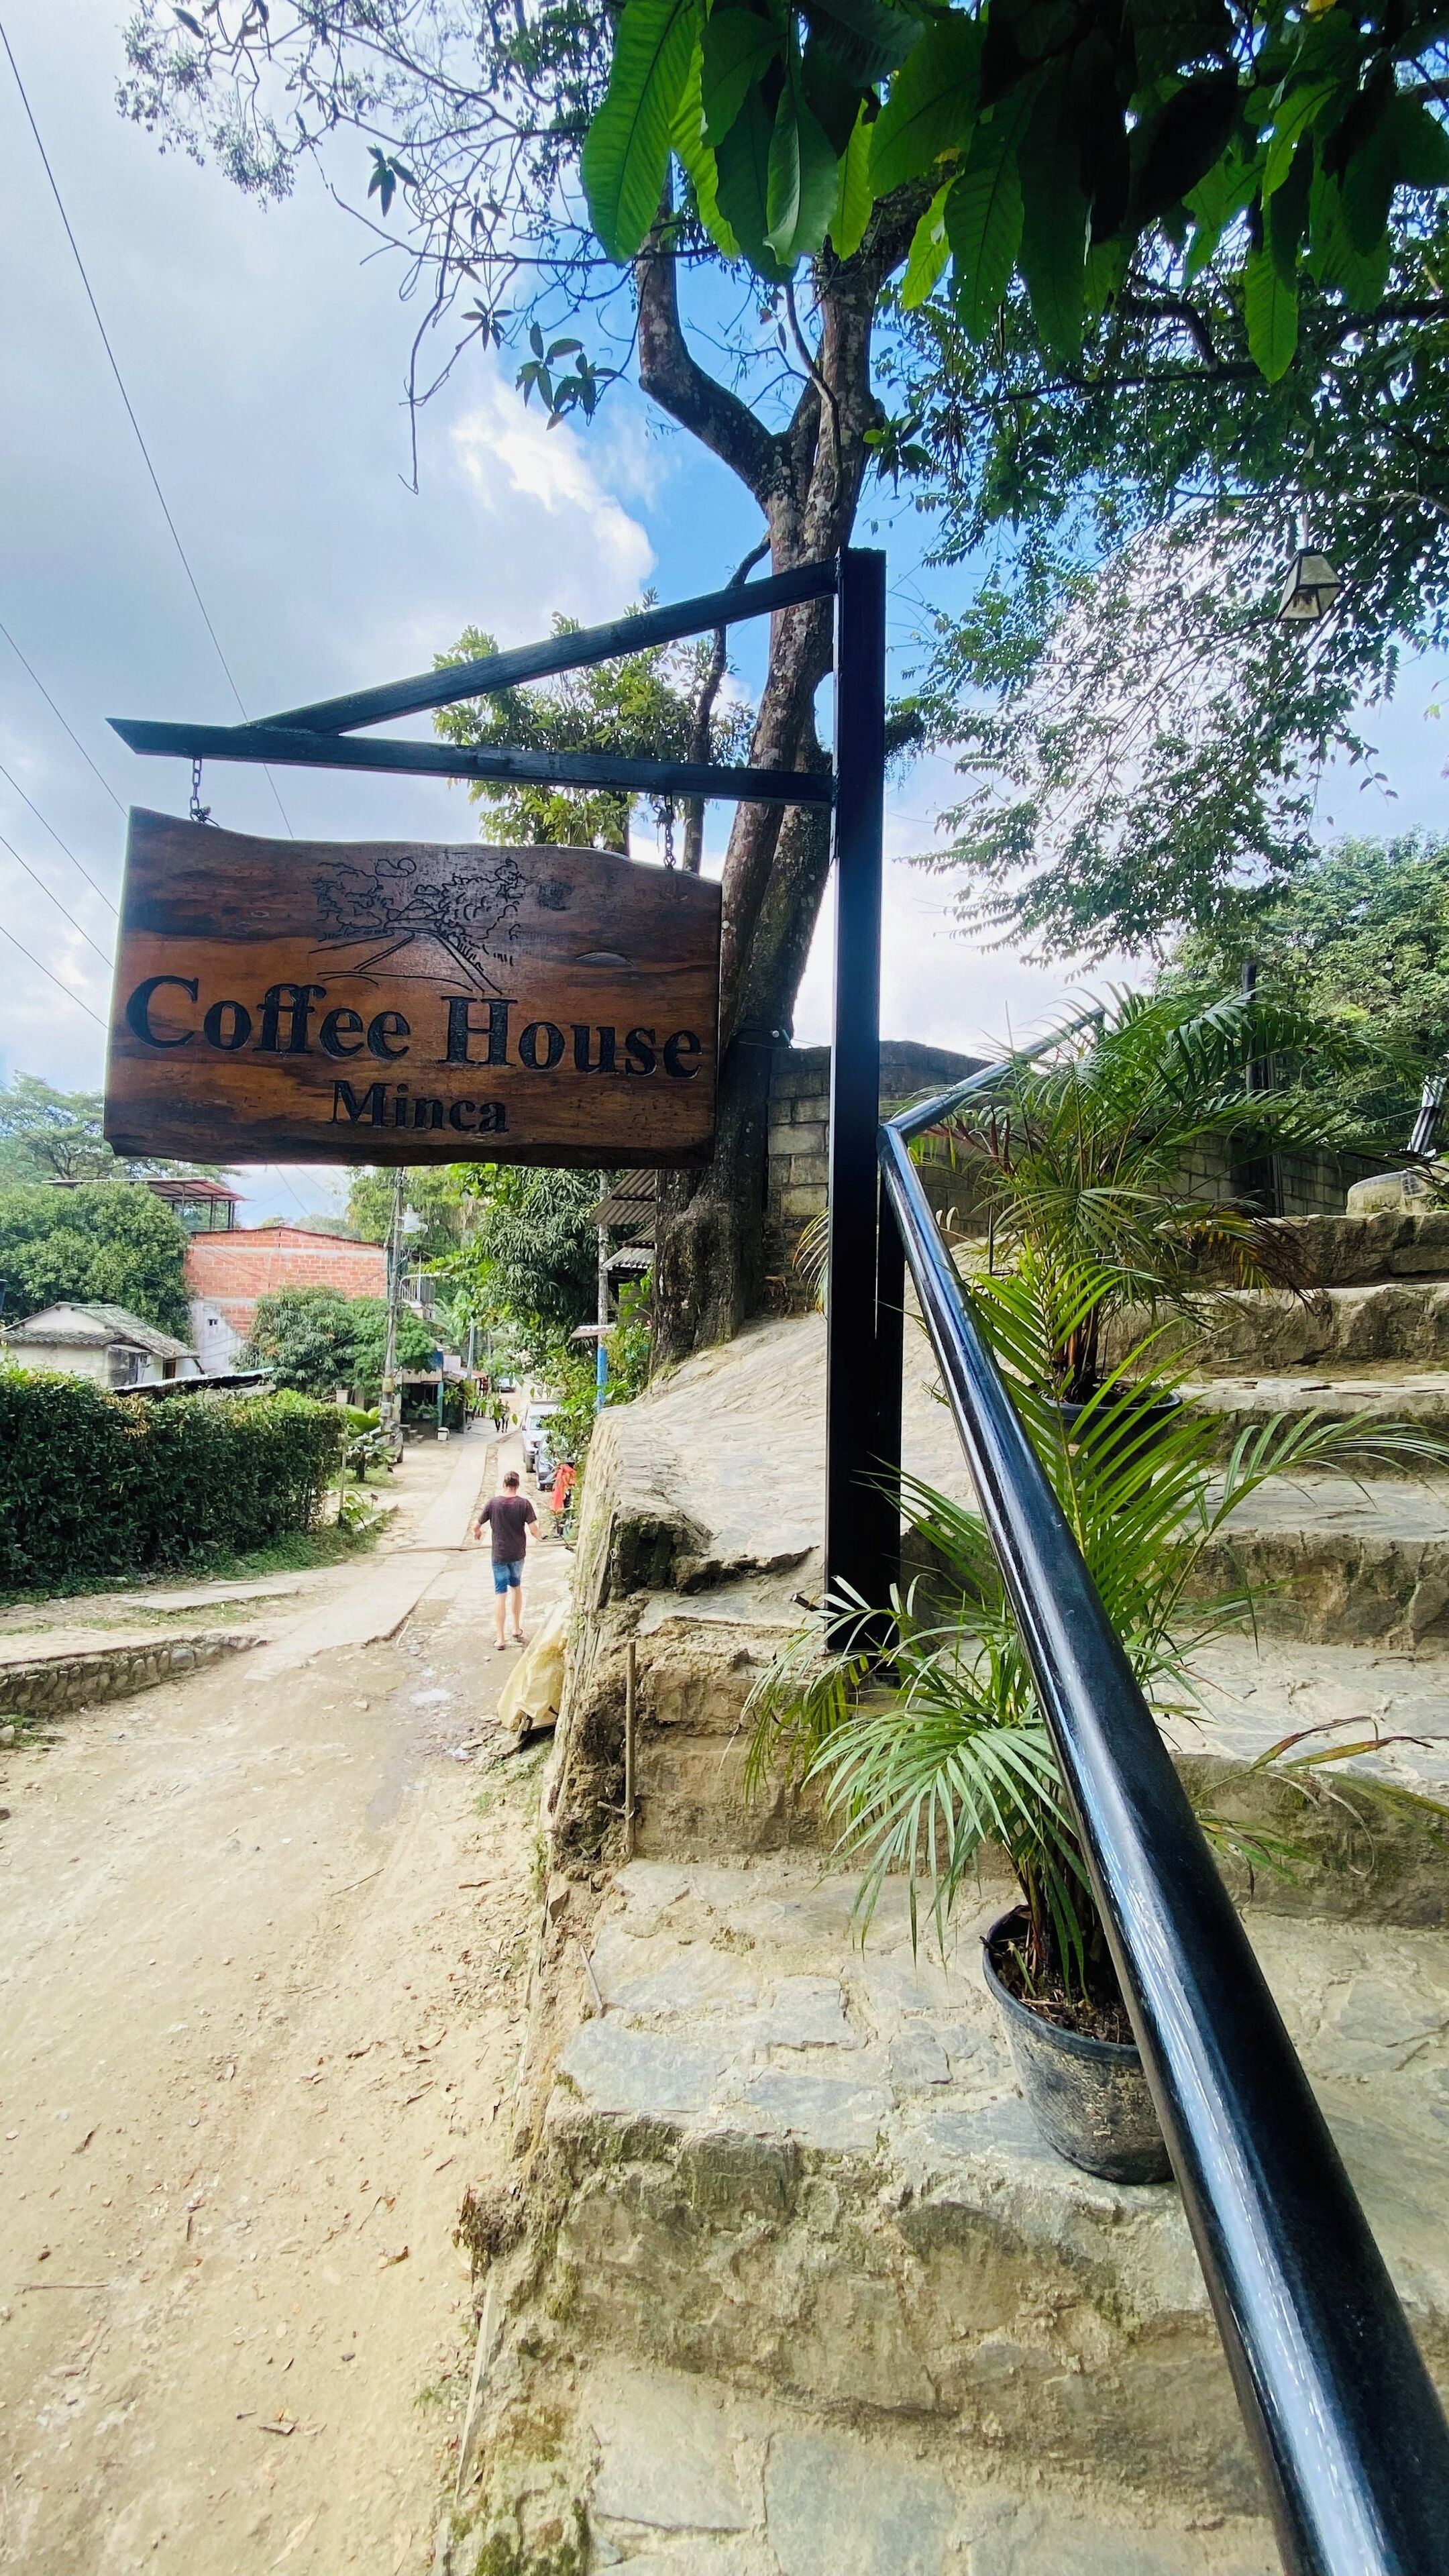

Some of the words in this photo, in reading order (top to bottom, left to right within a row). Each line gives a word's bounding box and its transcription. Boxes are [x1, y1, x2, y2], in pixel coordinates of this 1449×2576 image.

[126, 975, 411, 1060] Coffee
[438, 996, 702, 1079] House
[329, 1080, 510, 1133] Minca
